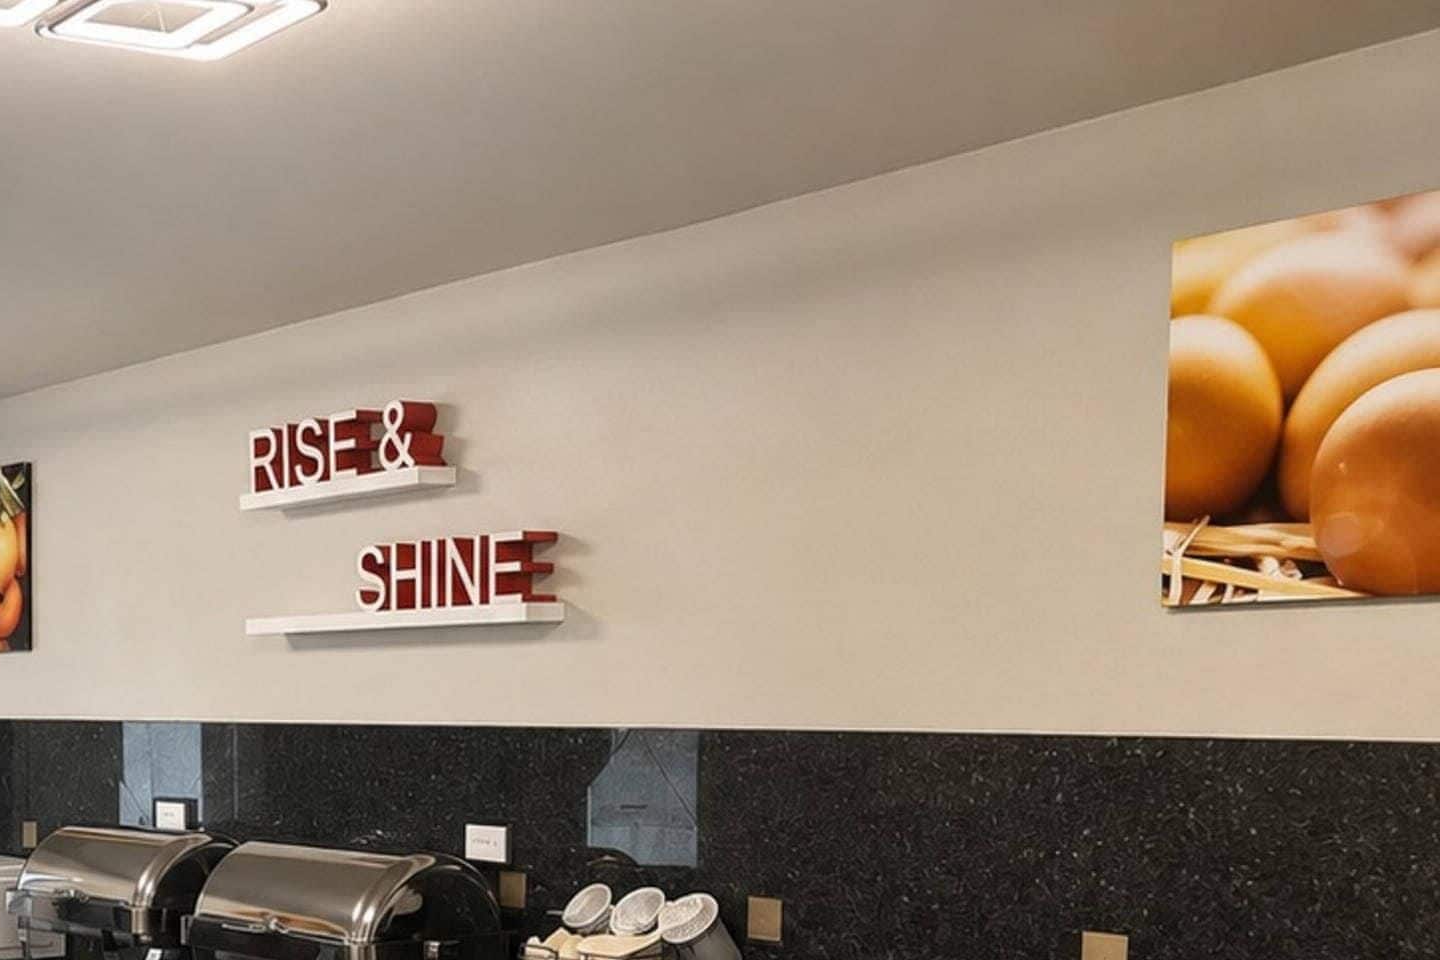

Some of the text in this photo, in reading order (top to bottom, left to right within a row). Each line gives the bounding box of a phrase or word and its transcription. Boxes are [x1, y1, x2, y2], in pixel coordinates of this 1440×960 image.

[248, 399, 416, 495] RISE &
[355, 530, 524, 613] SHINE
